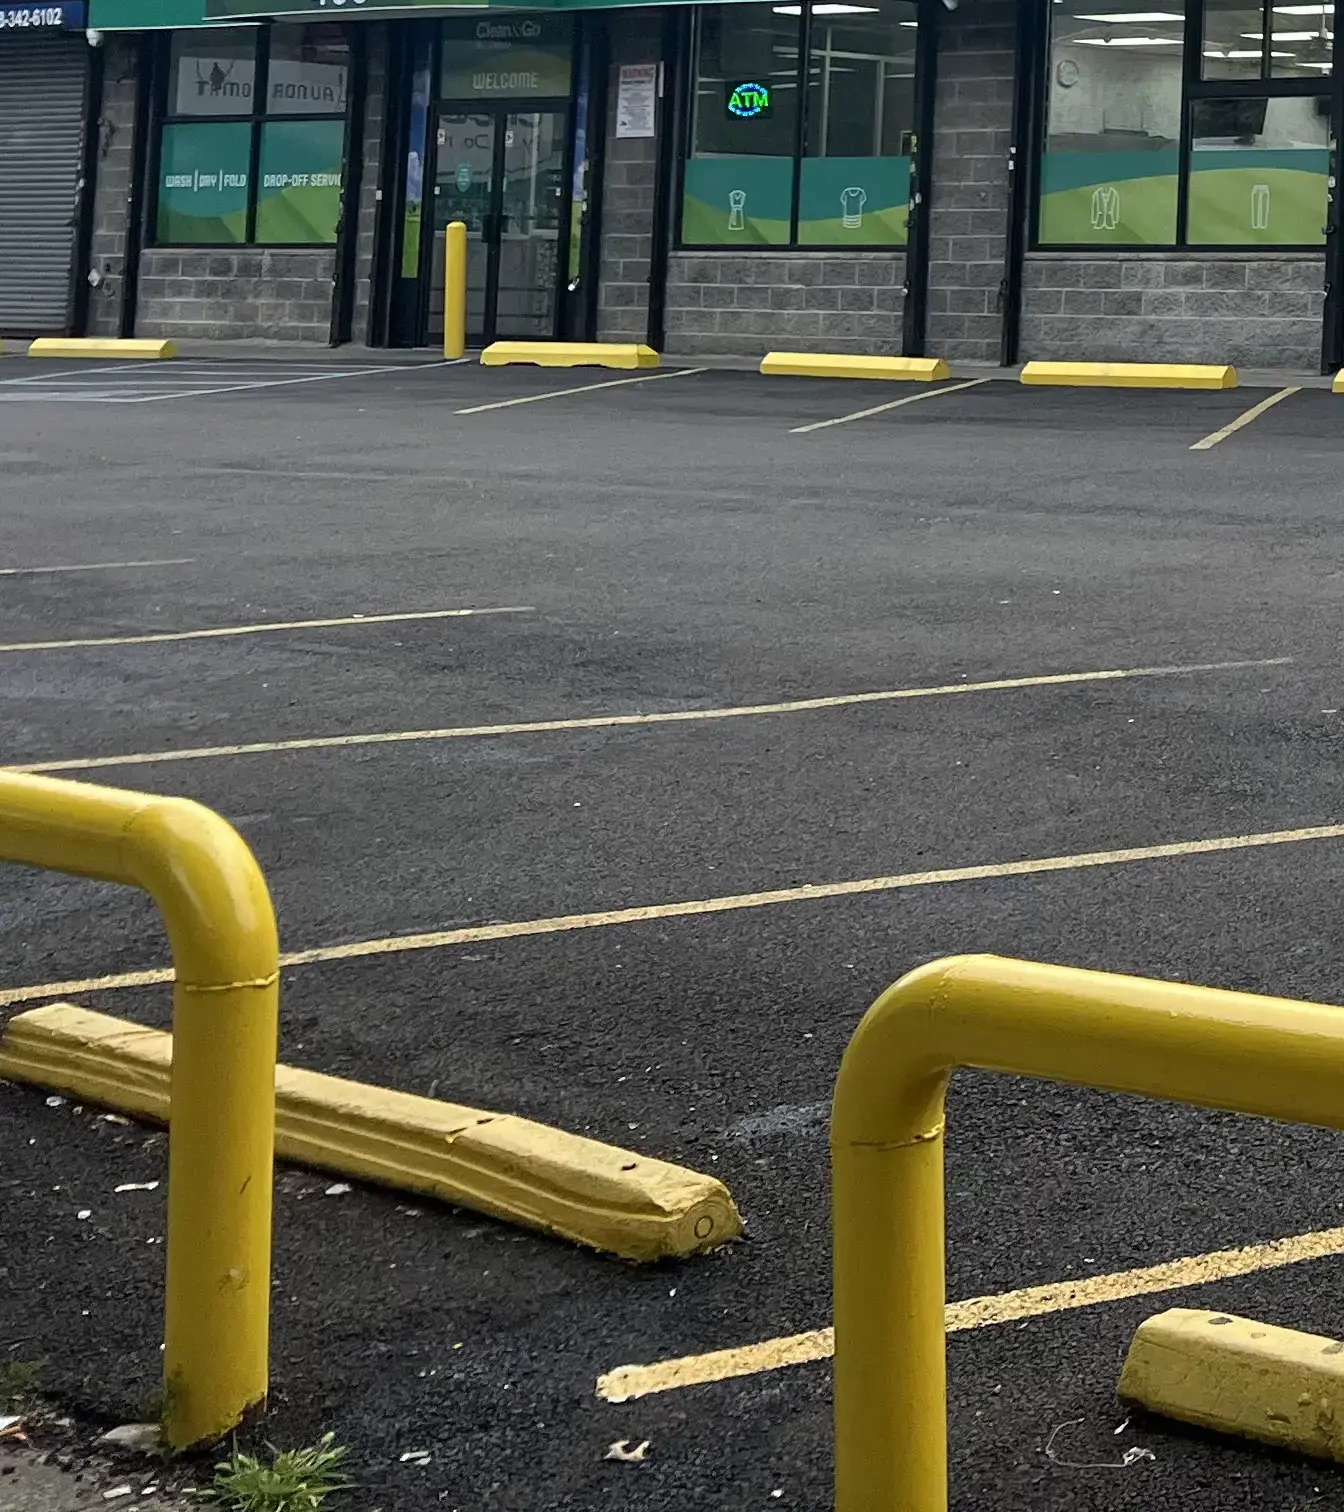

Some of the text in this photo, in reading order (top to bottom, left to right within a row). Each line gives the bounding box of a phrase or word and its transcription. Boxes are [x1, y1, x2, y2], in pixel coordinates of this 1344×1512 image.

[472, 71, 539, 90] WELCOME
[728, 91, 769, 108] ATM
[165, 174, 247, 188] WASH DRY FOLD
[263, 173, 309, 188] DROP-OFF
